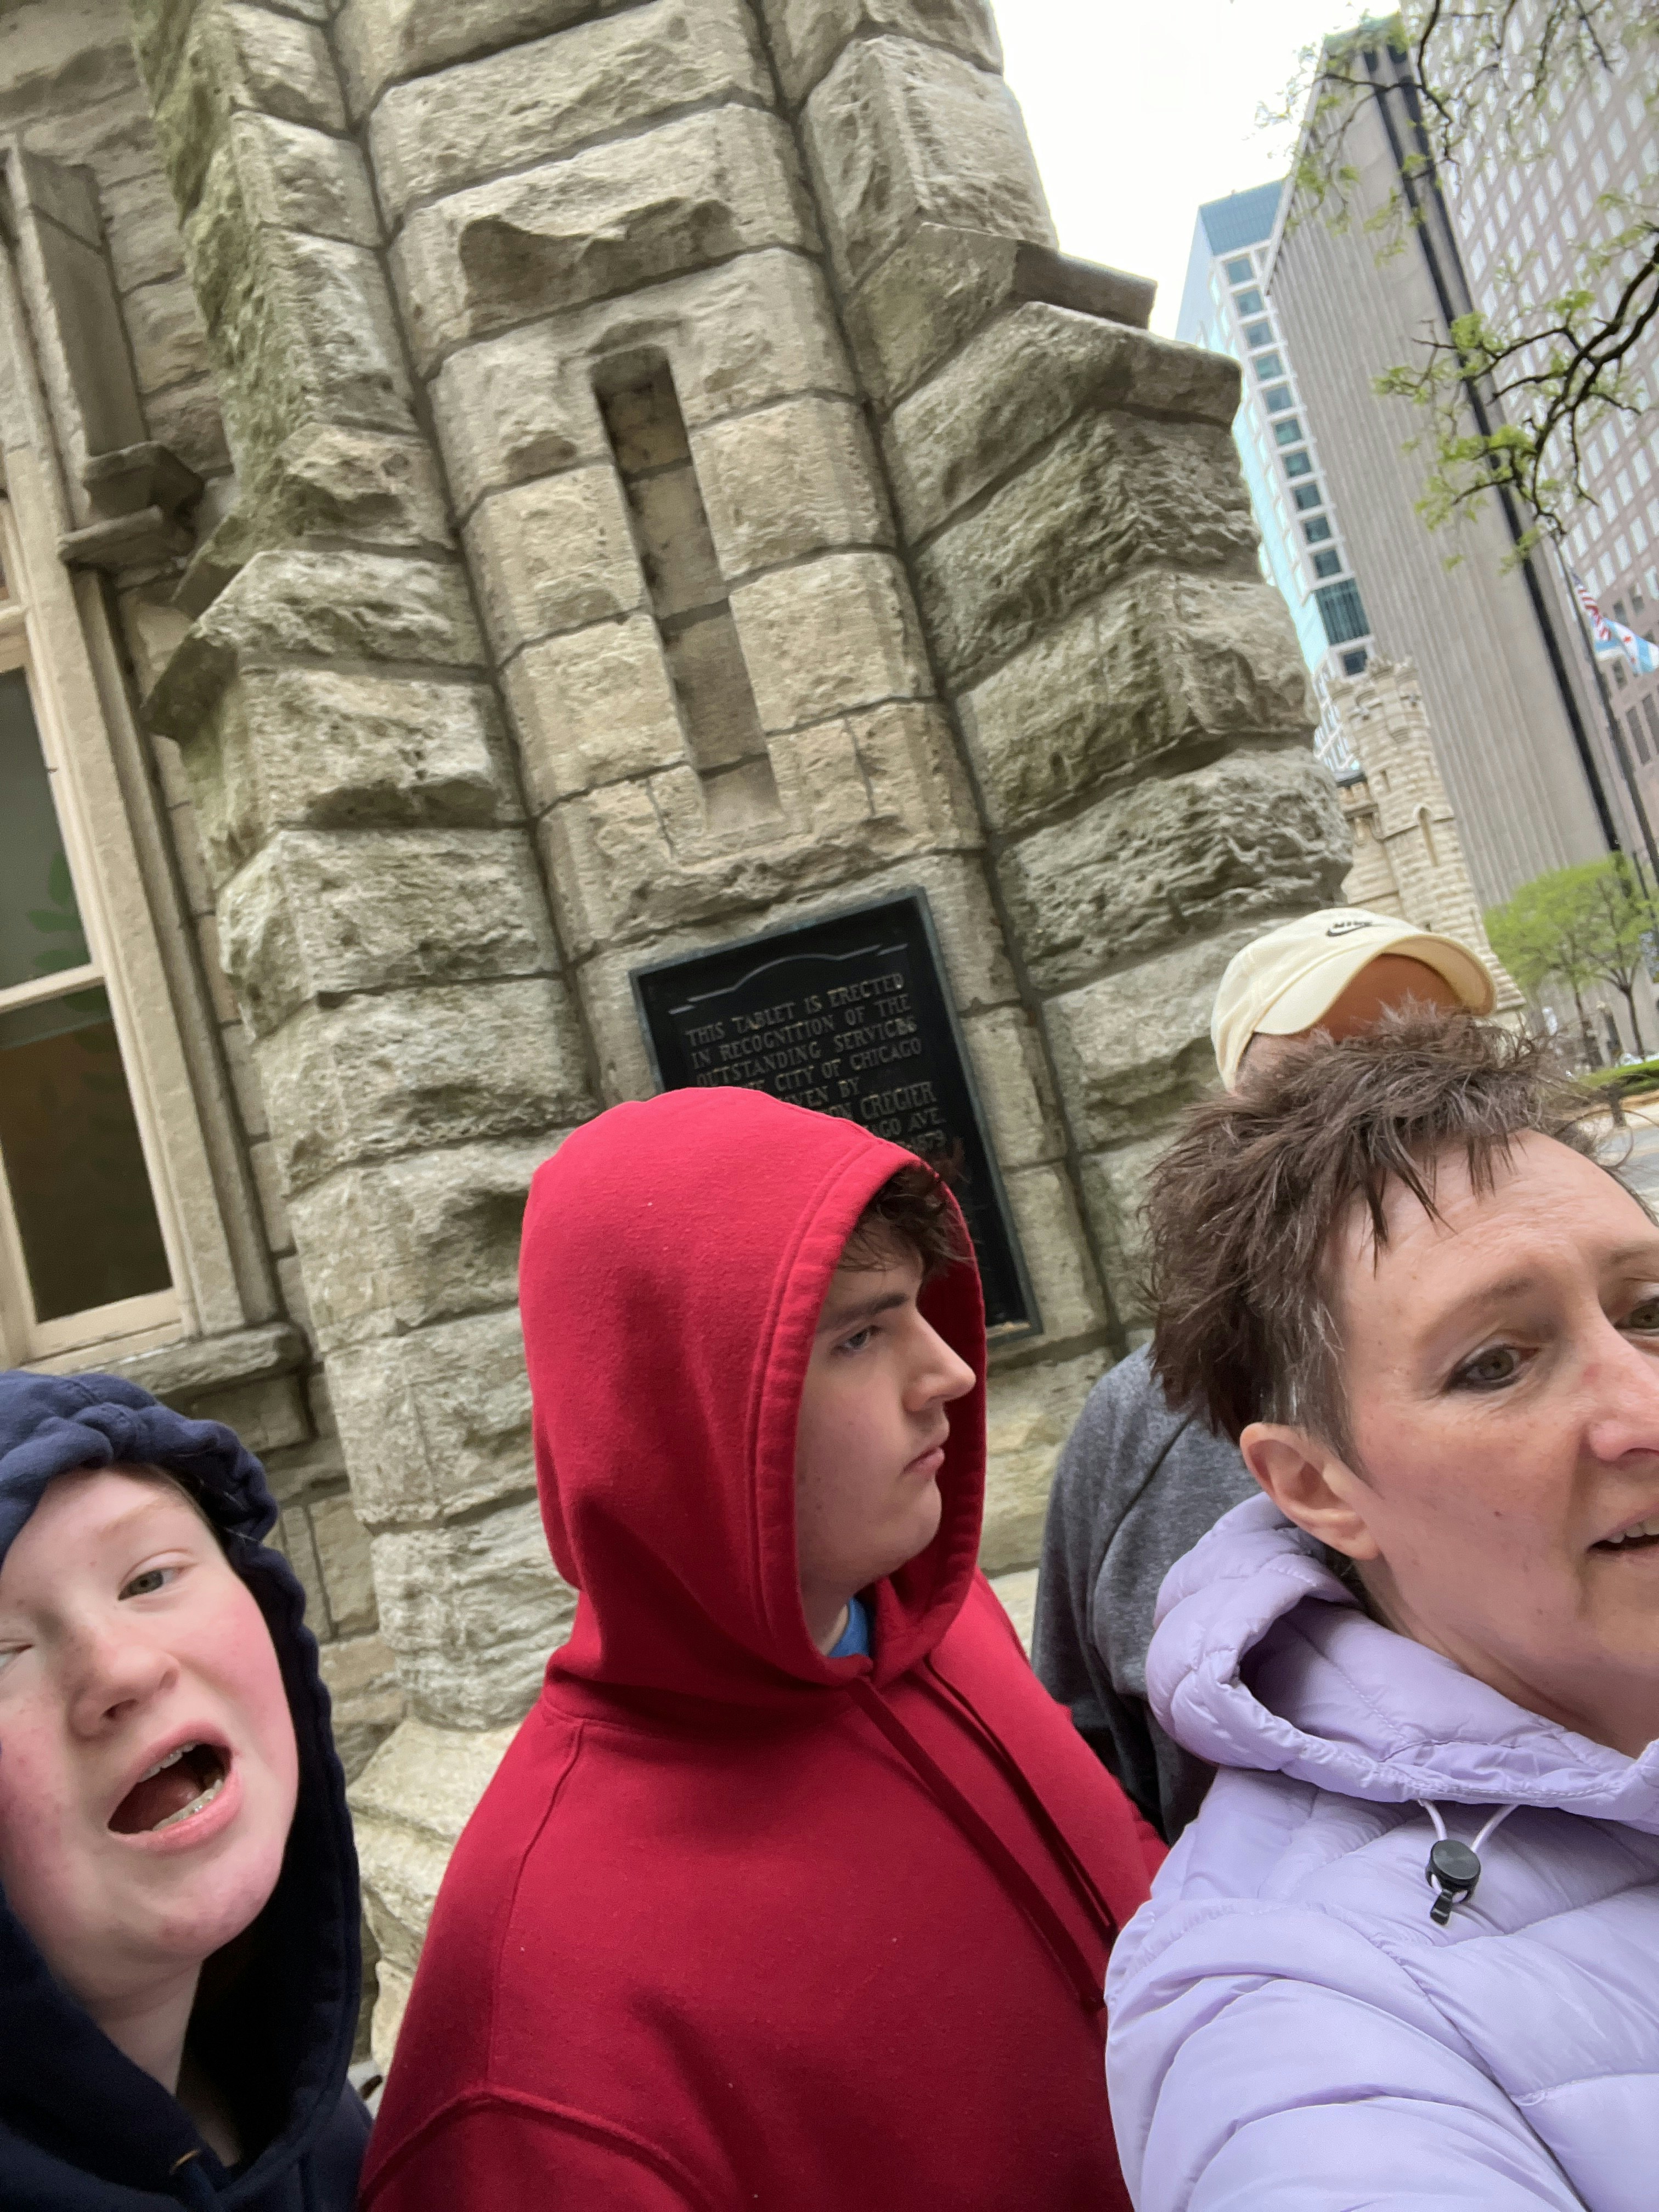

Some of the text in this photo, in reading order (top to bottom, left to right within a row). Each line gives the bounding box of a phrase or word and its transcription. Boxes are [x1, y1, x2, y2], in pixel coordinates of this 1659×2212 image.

[684, 973, 905, 1047] THIS TABLET IS ERECTED
[691, 992, 912, 1070] IN RECOGNITION OF THE
[696, 1015, 918, 1087] OUTSTANDING SERVICES
[774, 1064, 815, 1092] CITY
[821, 1058, 842, 1079] OF
[849, 1036, 923, 1070] CHICAGO
[837, 1075, 860, 1099] BY
